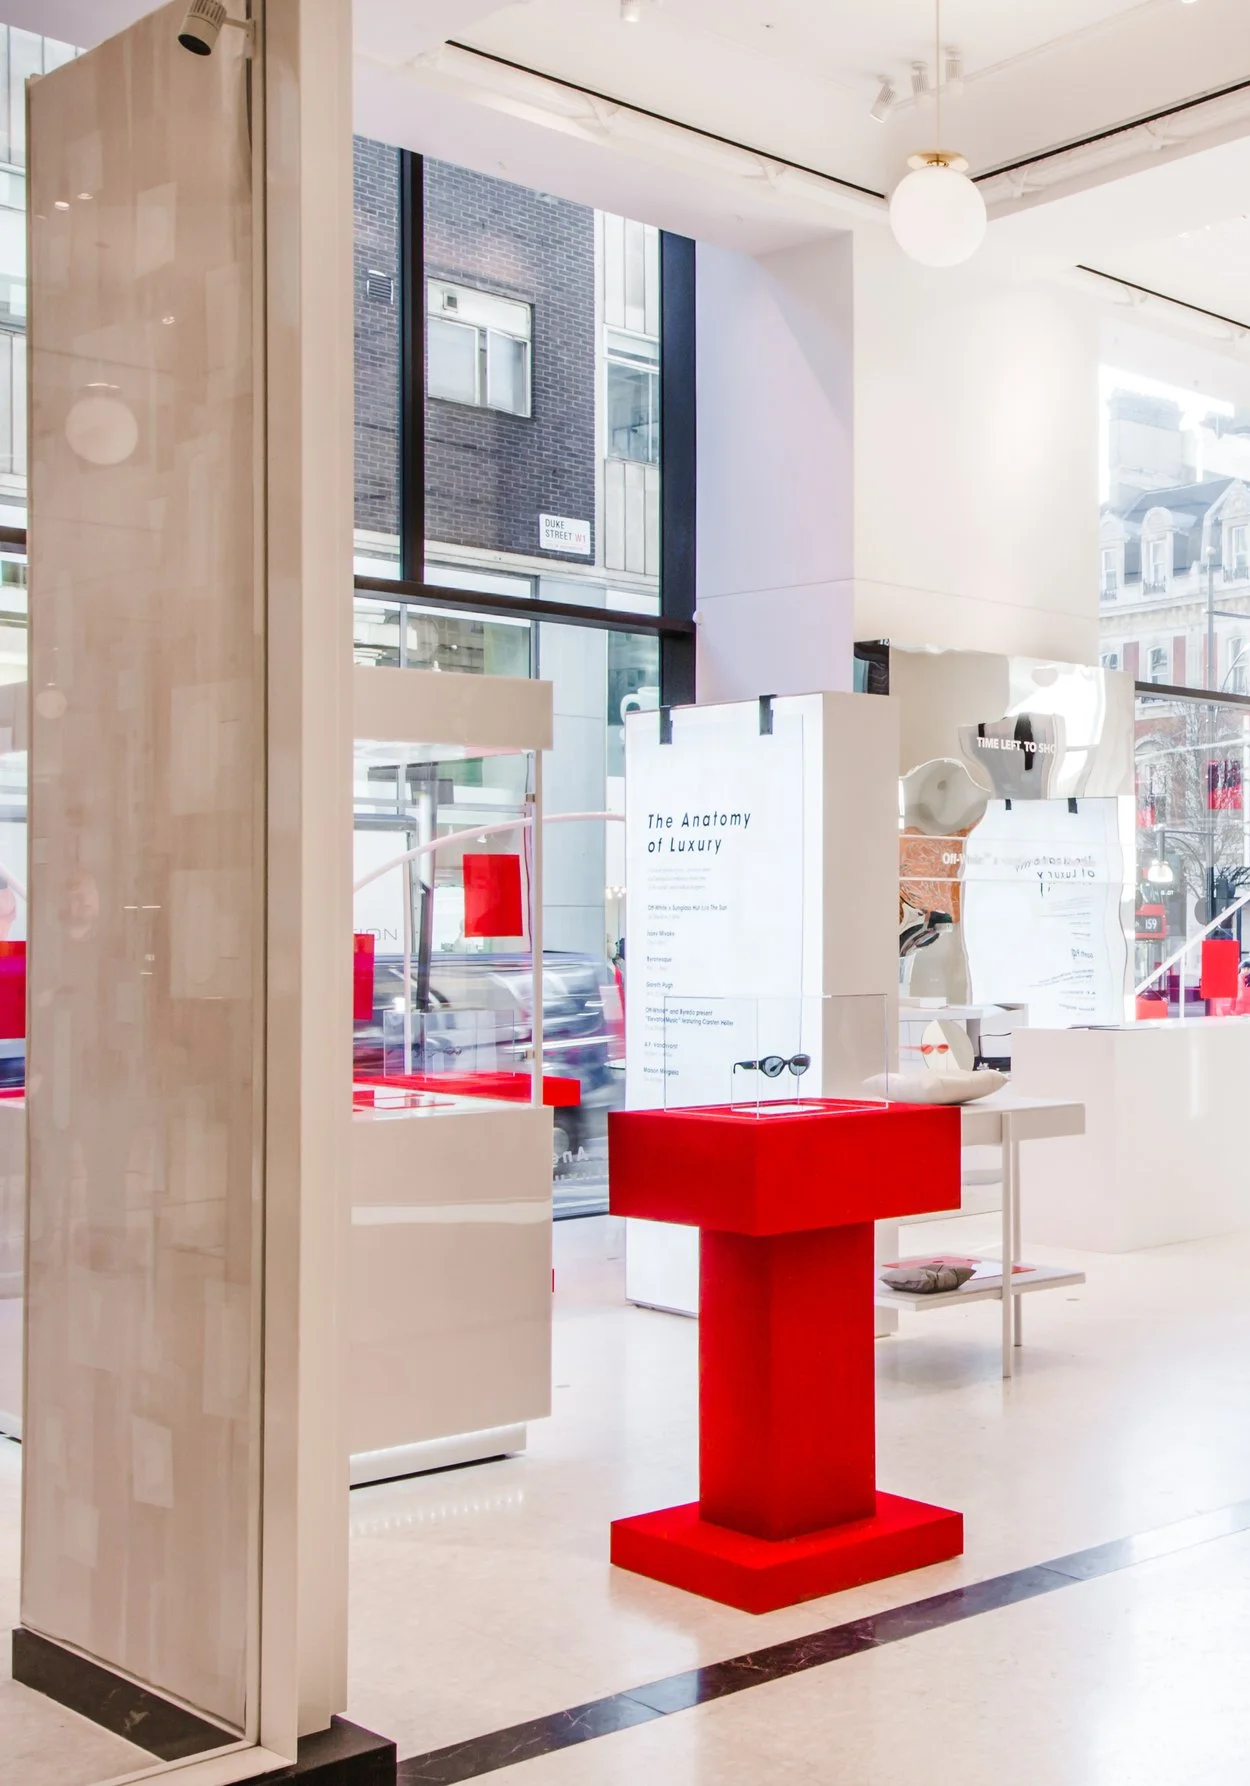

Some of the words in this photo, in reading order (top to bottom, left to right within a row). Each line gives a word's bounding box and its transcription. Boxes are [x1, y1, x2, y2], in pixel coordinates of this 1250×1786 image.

[545, 519, 565, 529] DUKE
[545, 529, 572, 541] STREET
[575, 533, 586, 543] W1
[976, 736, 999, 749] TIME
[1000, 740, 1022, 751] LEFT
[1024, 741, 1037, 753] TO
[648, 813, 673, 829] The
[681, 811, 751, 829] Anatomy
[648, 837, 662, 853] of
[670, 837, 722, 855] Luxury
[1145, 918, 1158, 930] 159
